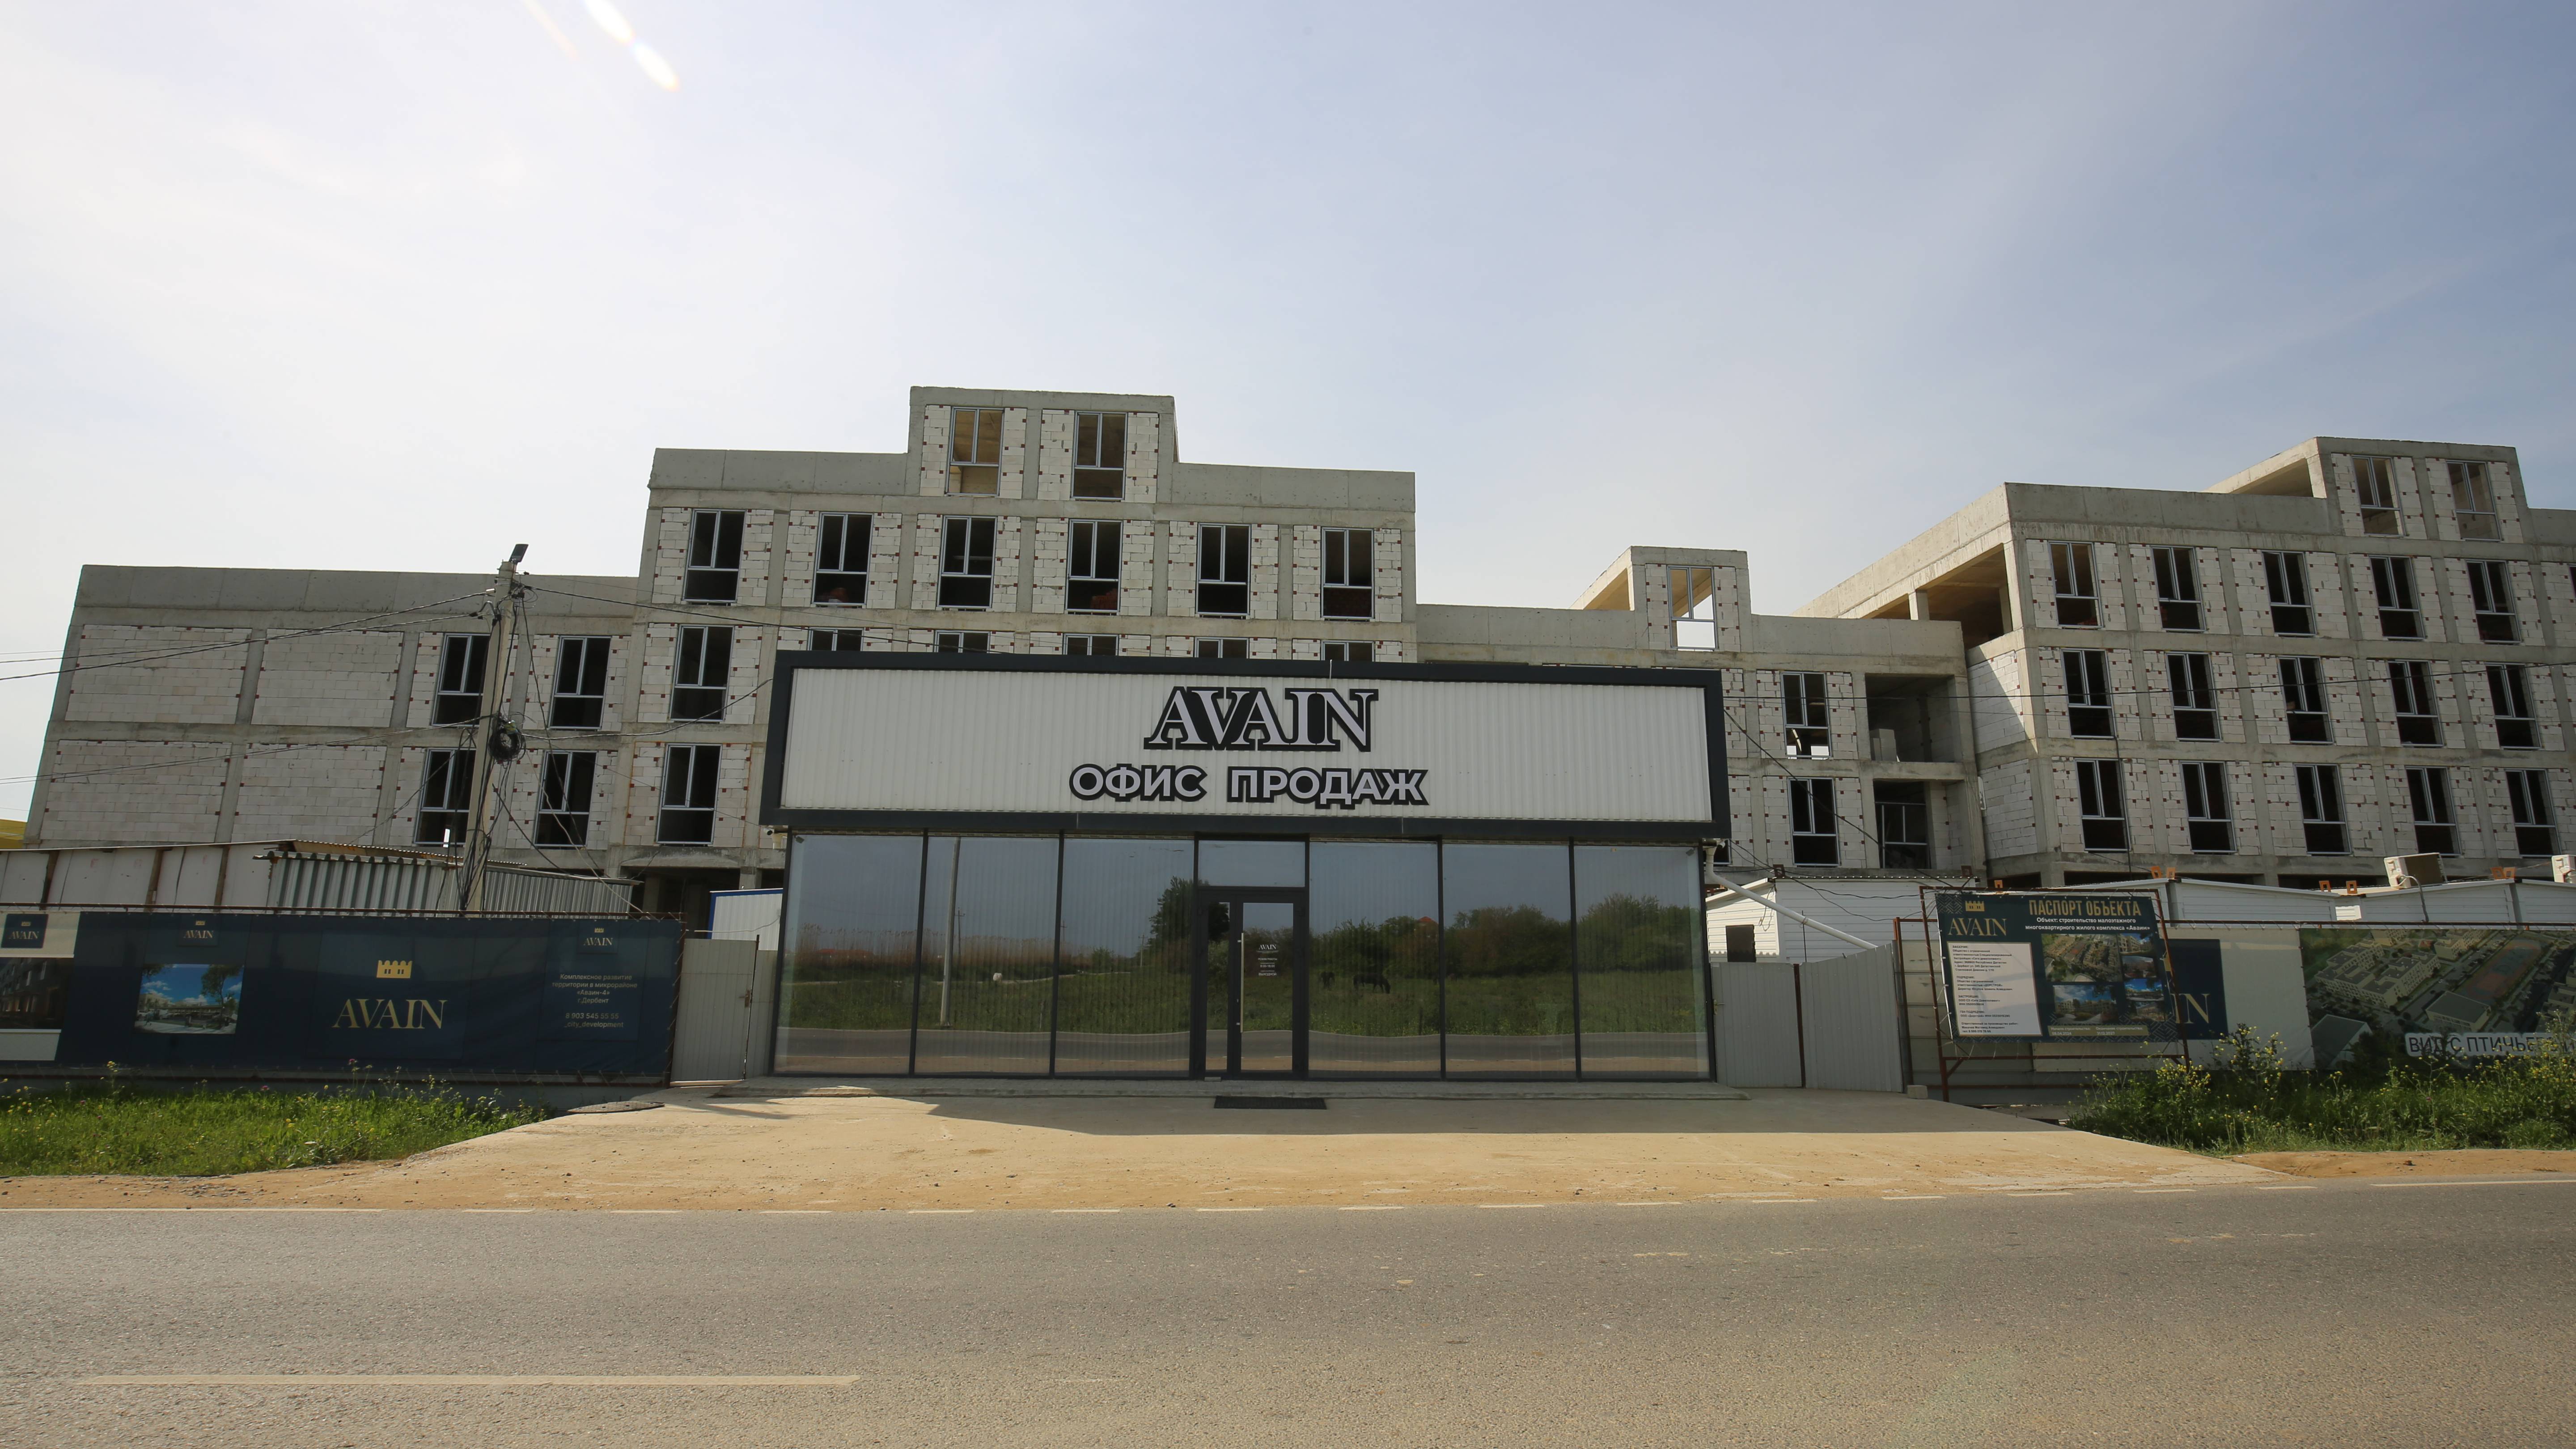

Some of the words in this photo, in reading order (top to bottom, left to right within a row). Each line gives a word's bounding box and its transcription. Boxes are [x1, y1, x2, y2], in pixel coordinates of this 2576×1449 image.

[1146, 689, 1377, 749] AVAIN
[1071, 766, 1205, 799] ОФИС
[1230, 768, 1427, 807] ПРОДАЖ
[2029, 900, 2082, 915] ПАСПОРТ
[2086, 901, 2141, 916] ОБЪЕКТА
[183, 930, 214, 939] AVAIN
[1948, 918, 2007, 936] AVAIN
[9, 931, 39, 940] AVAIN
[583, 937, 613, 946] AVAIN
[332, 999, 448, 1029] AVAIN
[2450, 1037, 2462, 1052] С
